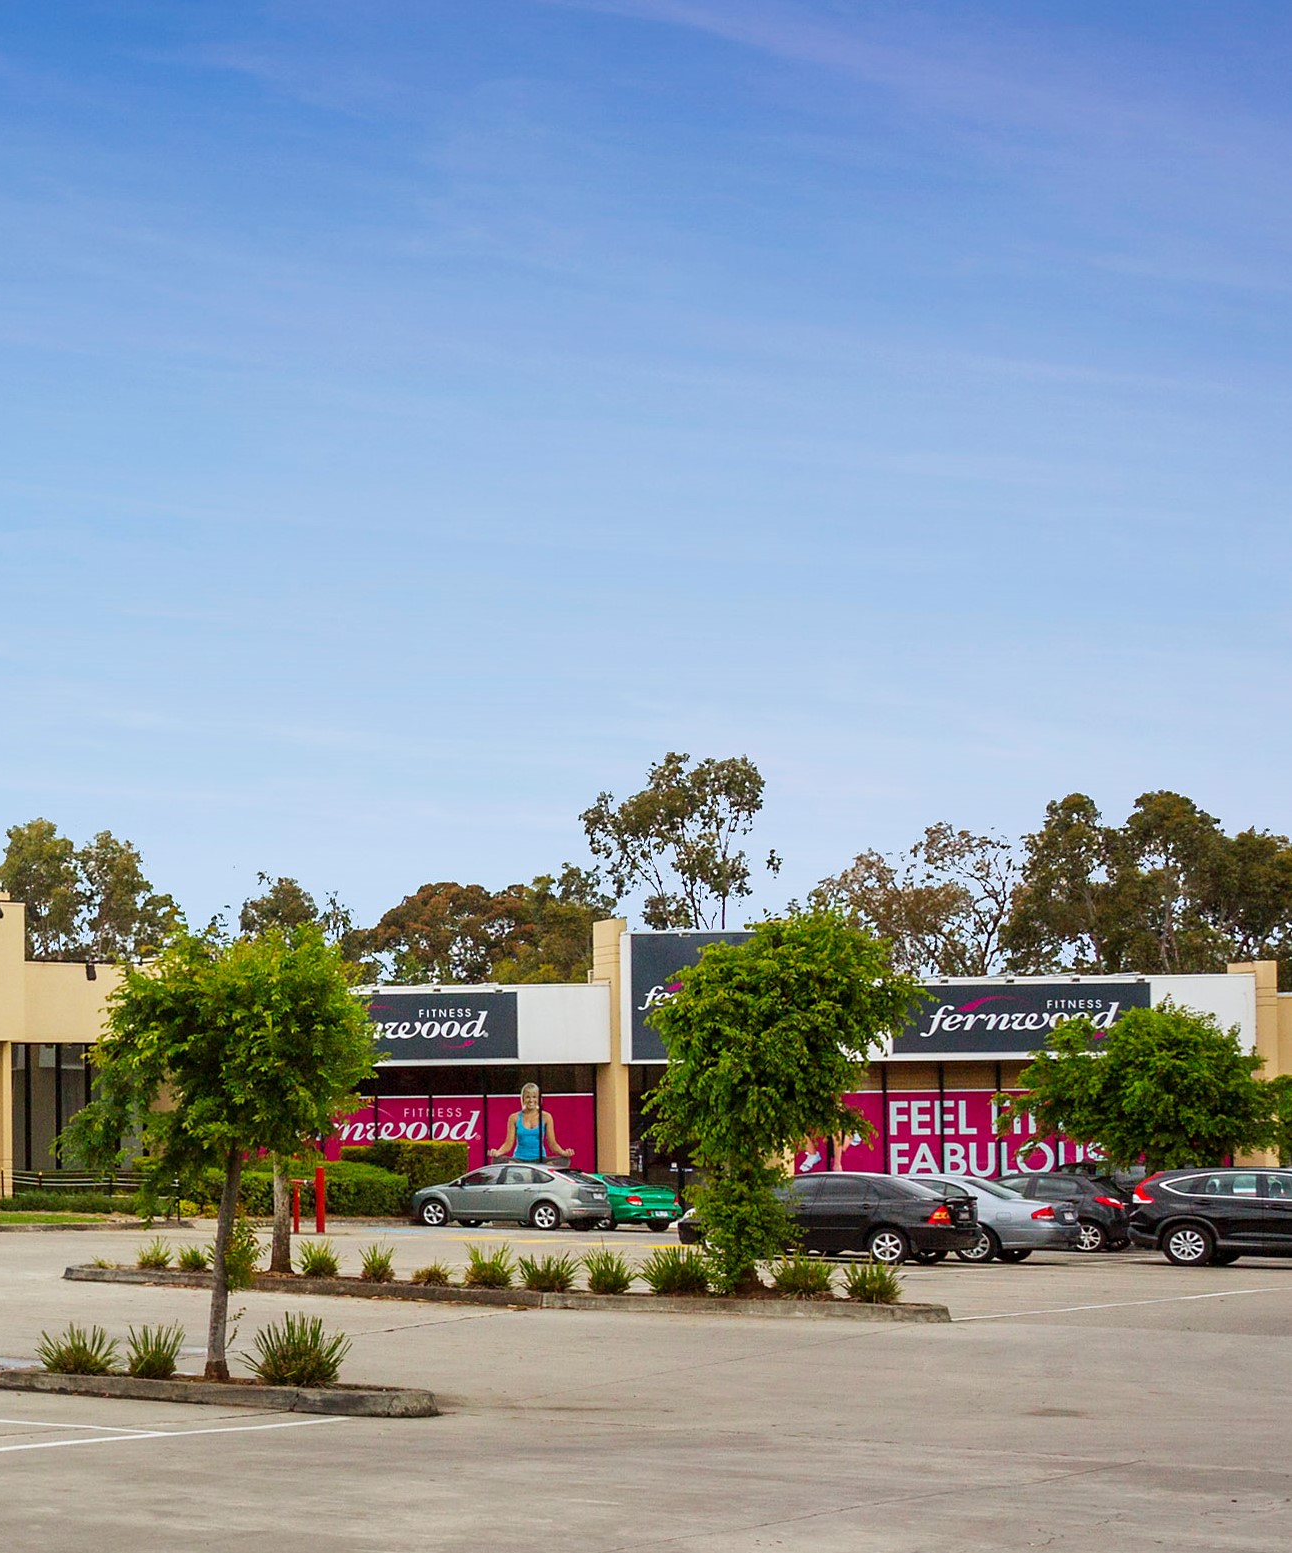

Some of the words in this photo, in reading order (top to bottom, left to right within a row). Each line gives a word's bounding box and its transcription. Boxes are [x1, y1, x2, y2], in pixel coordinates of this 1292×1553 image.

[1046, 999, 1103, 1009] FITNESS
[418, 1008, 472, 1018] FITNESS
[404, 1107, 463, 1118] FITNESS
[889, 1100, 978, 1135] FEEL
